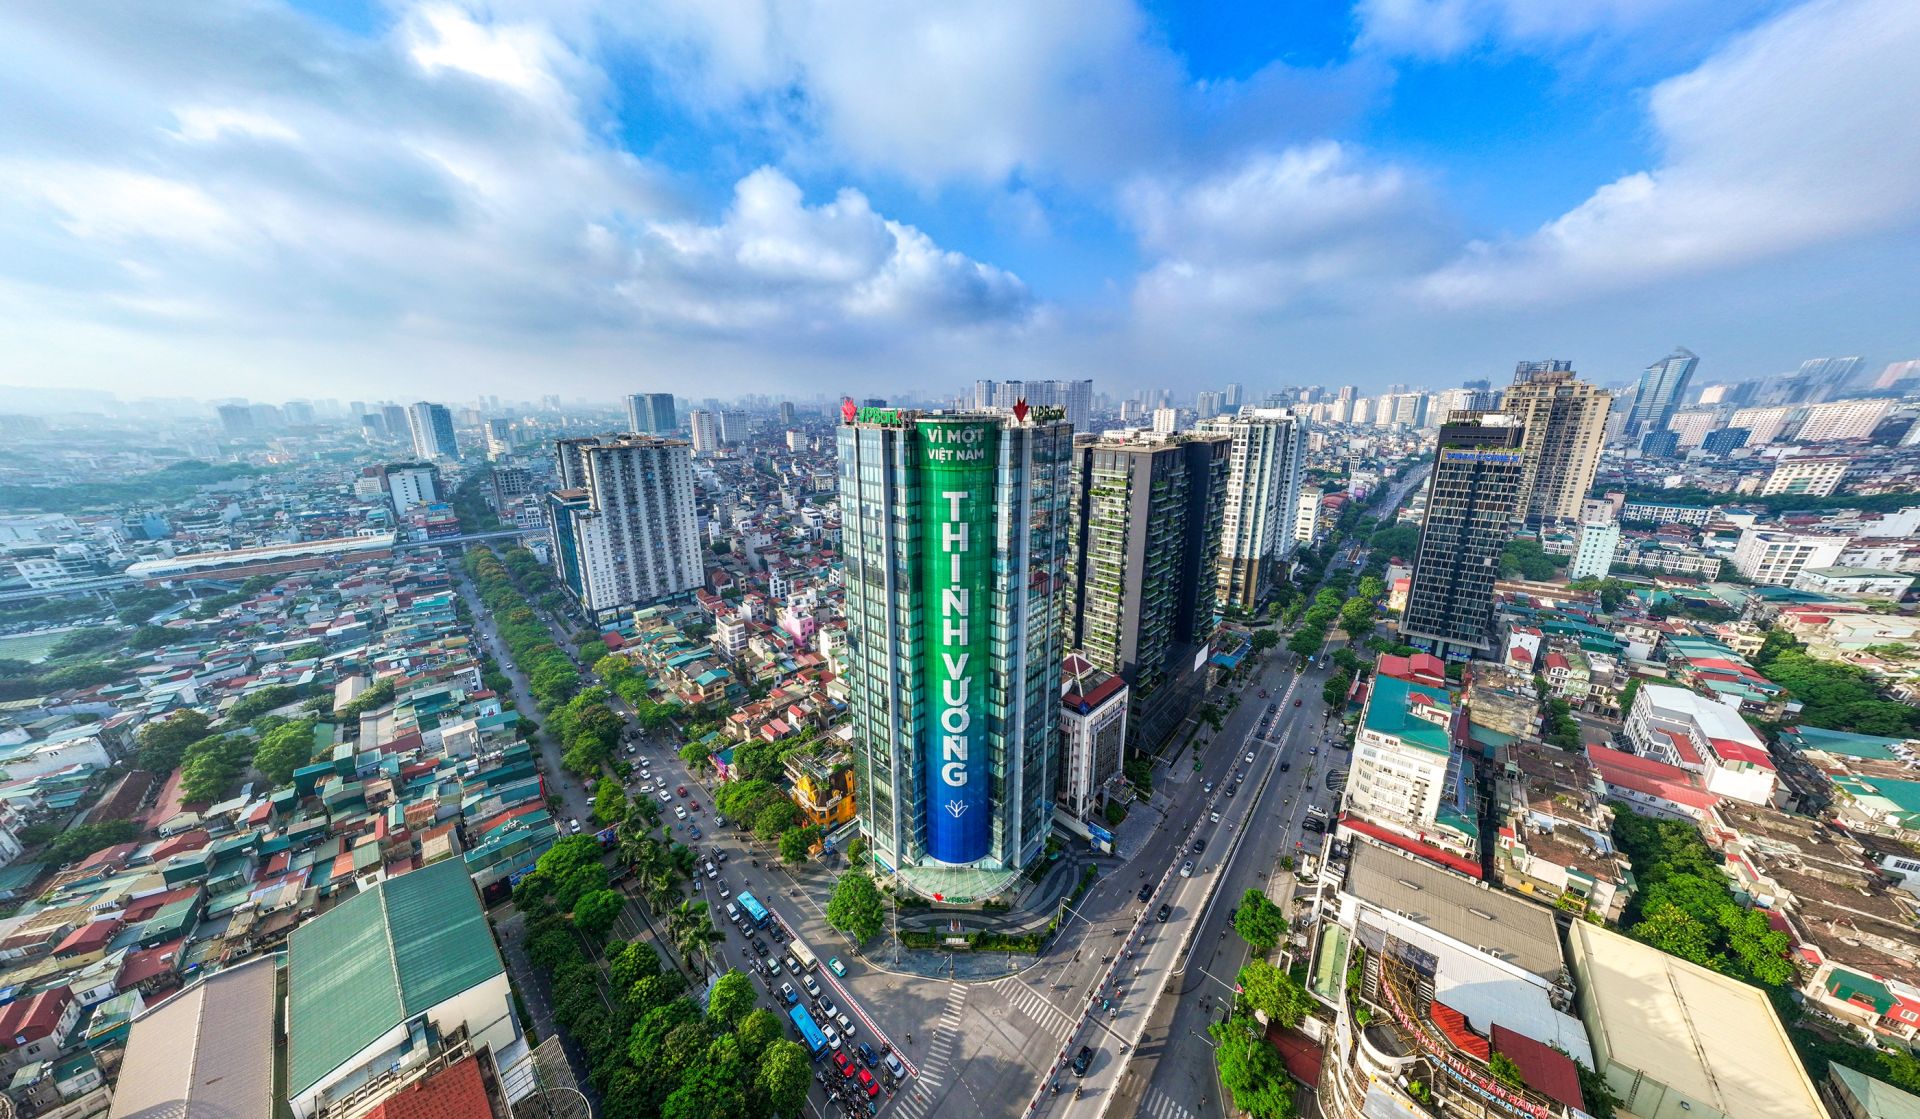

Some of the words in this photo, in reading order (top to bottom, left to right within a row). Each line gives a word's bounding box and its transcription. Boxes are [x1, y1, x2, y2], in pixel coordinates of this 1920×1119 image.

[858, 406, 902, 424] VPBank
[1030, 404, 1066, 421] VPBank
[927, 425, 943, 443] VÌ
[947, 426, 984, 447] MỘT
[927, 447, 953, 463] VIỆT
[956, 448, 984, 460] NAM
[945, 896, 976, 904] VPBank
